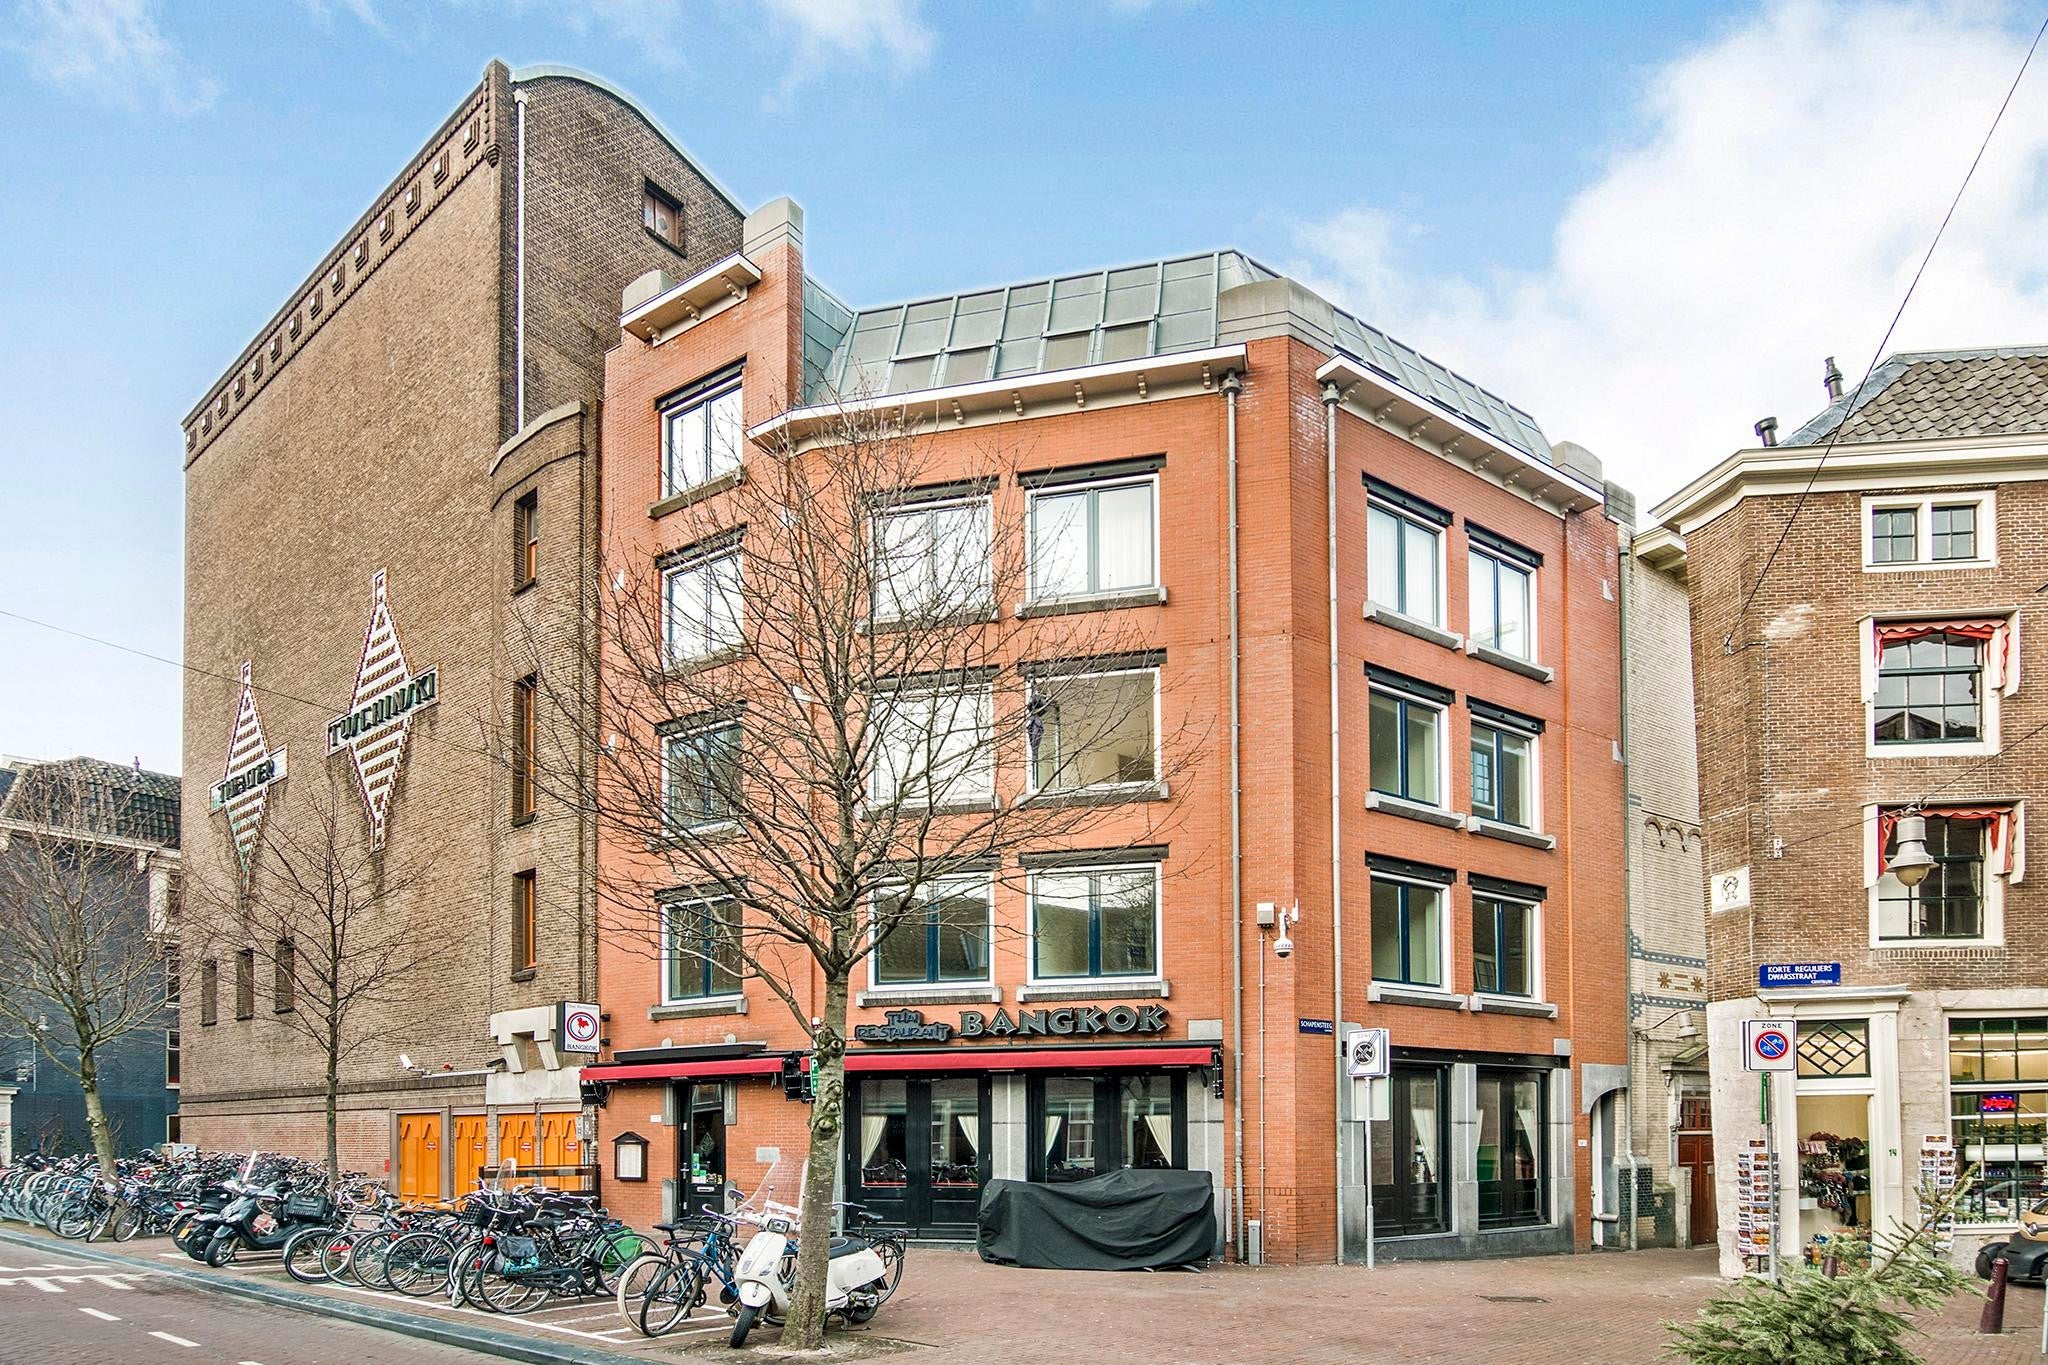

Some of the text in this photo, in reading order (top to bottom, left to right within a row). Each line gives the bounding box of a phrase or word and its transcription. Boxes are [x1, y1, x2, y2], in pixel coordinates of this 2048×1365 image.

[217, 758, 275, 803] THEATER
[887, 1012, 919, 1025] THAI
[959, 1004, 1169, 1037] BANGKOK
[1300, 1021, 1333, 1029] SCHAPENSTEEG
[857, 1024, 948, 1039] RESTAURANT
[1889, 1148, 1896, 1156] 14
